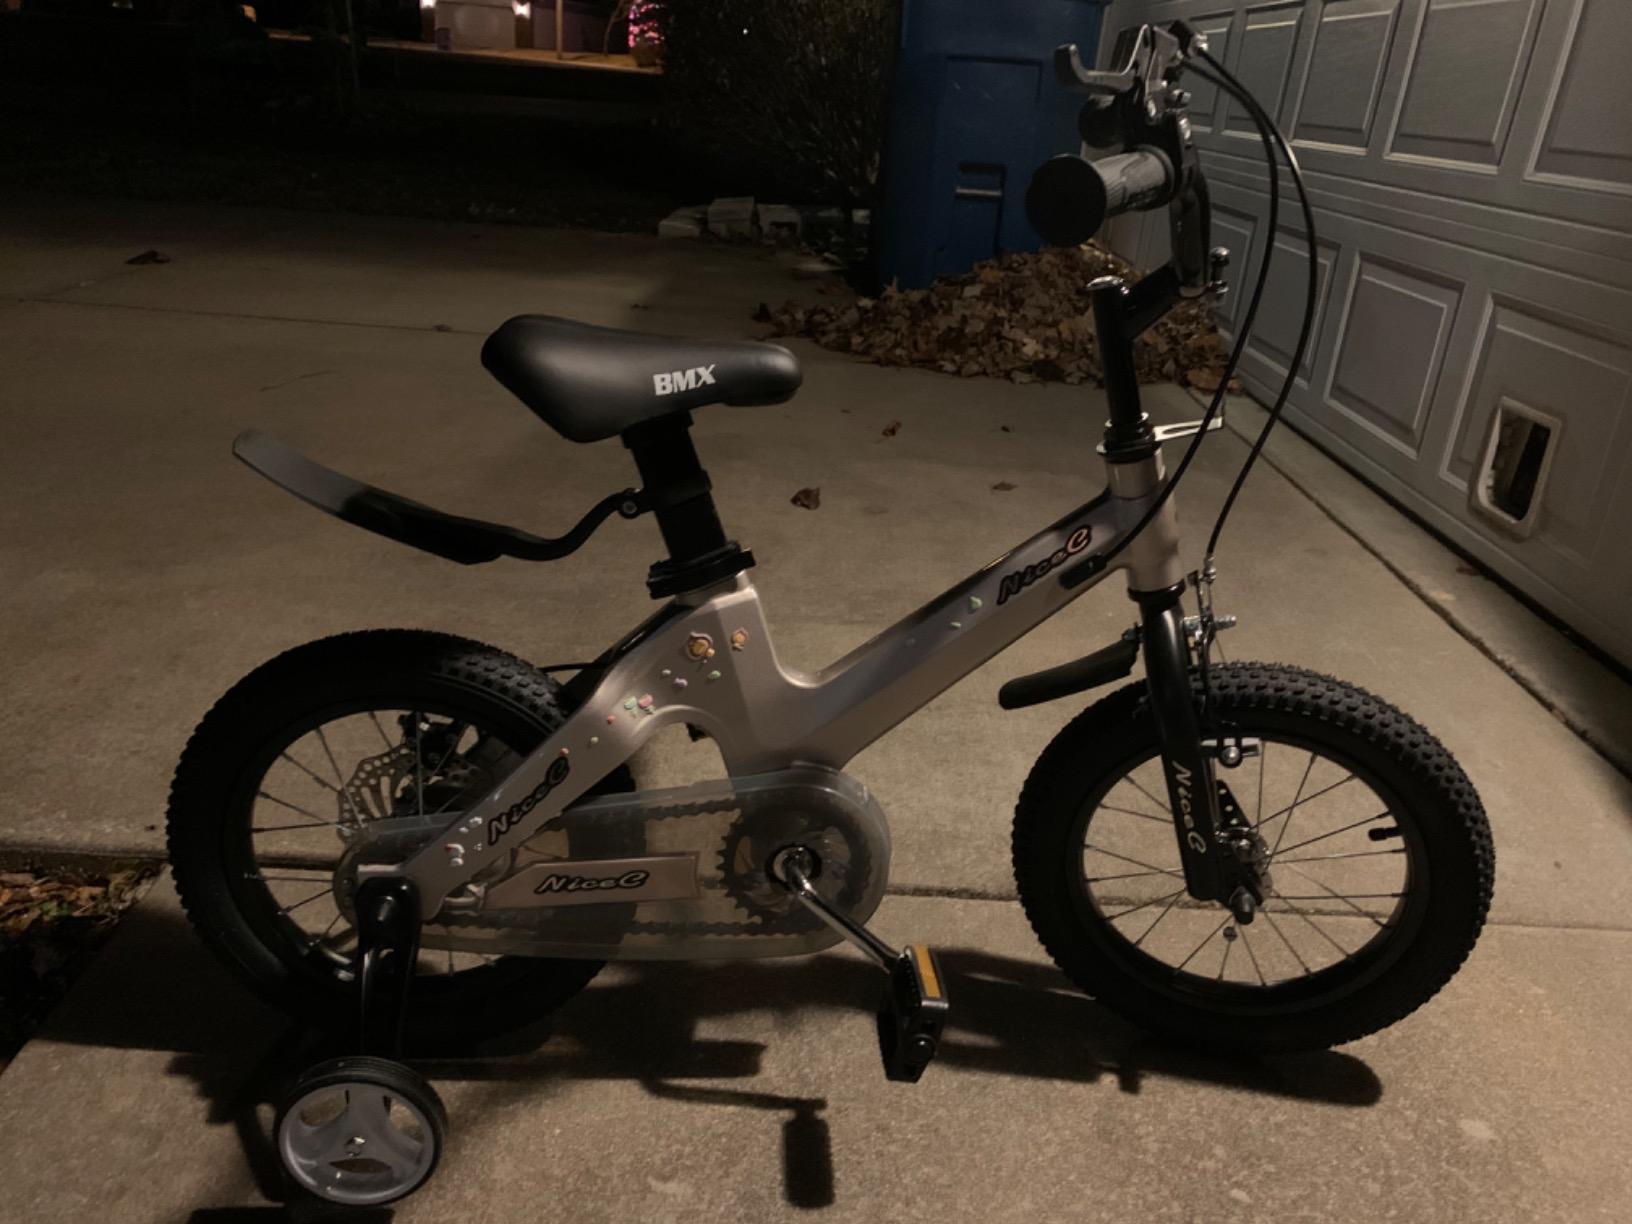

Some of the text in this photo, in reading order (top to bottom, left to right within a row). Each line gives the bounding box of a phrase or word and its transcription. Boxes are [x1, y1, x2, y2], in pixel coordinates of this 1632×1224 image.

[653, 364, 715, 395] BMX
[998, 525, 1091, 604] NiceC
[488, 757, 569, 845] NiceC
[534, 869, 649, 894] NiceC
